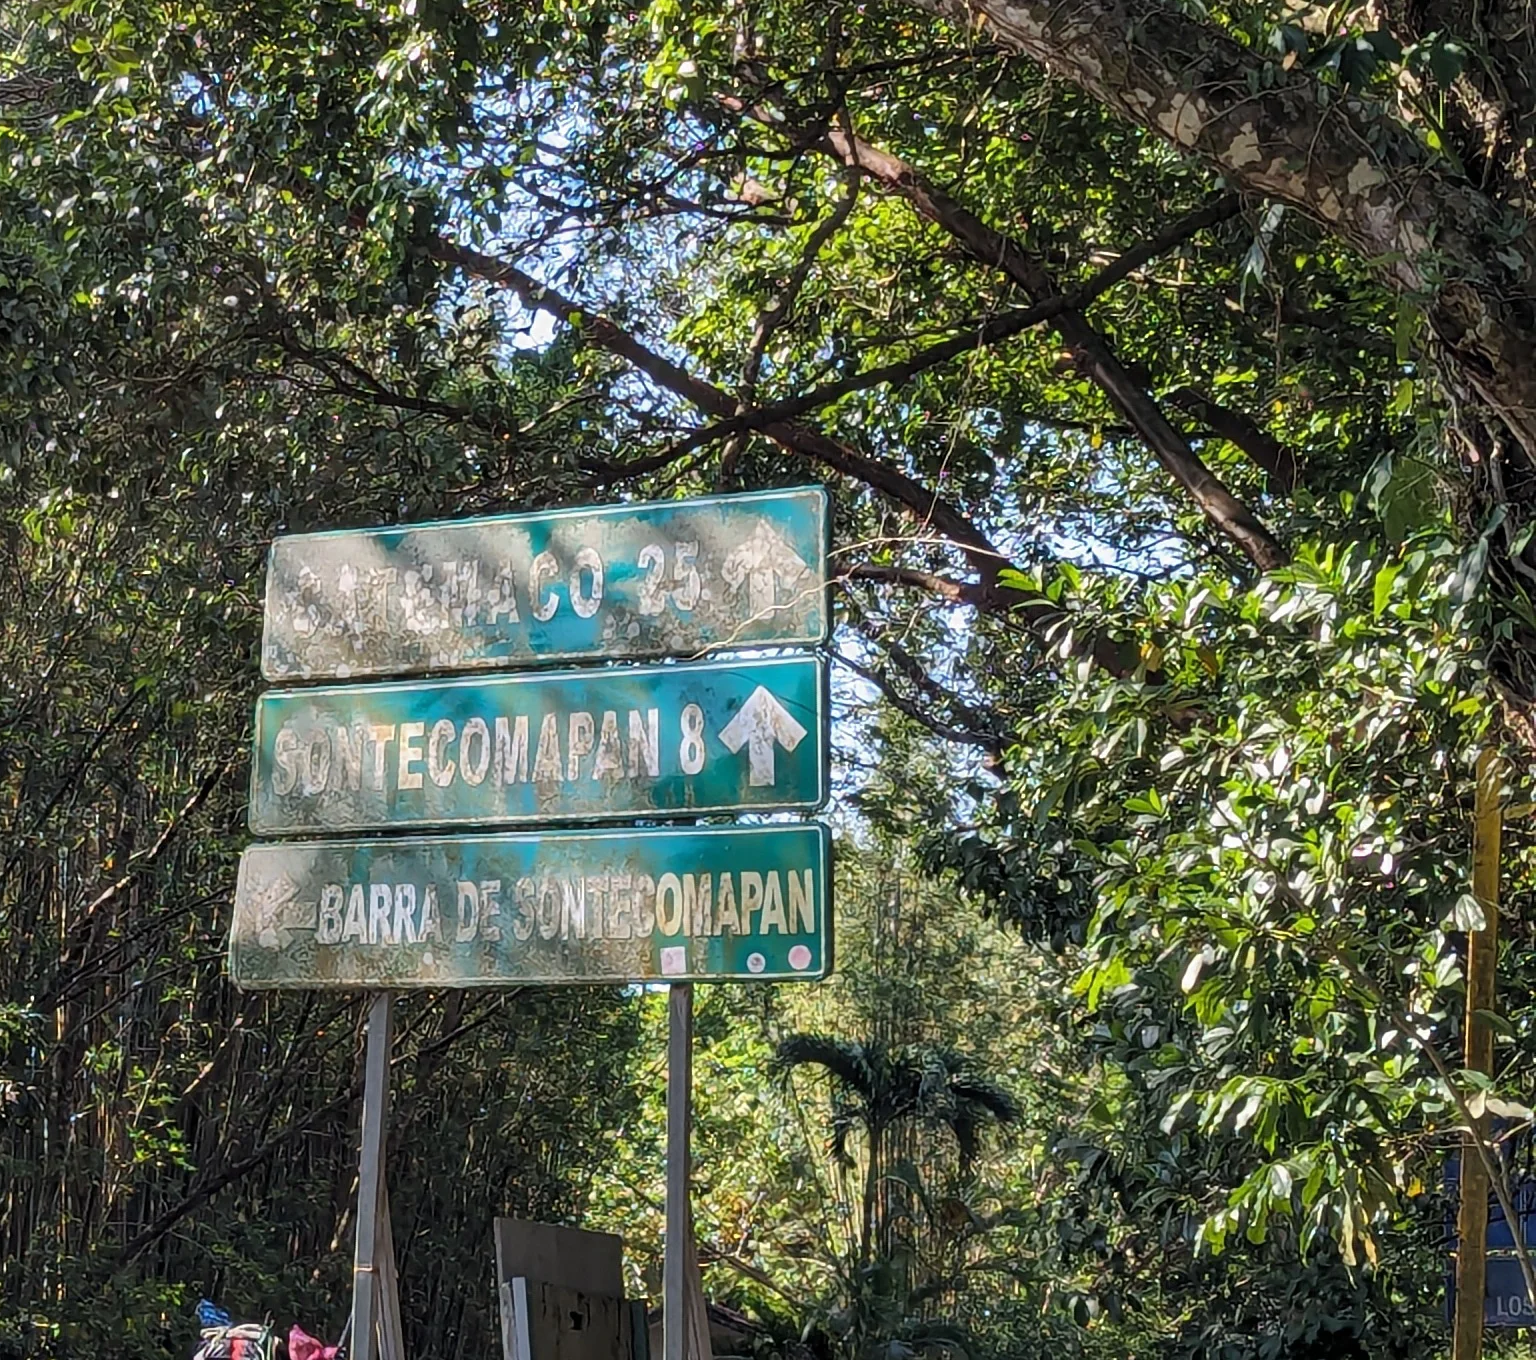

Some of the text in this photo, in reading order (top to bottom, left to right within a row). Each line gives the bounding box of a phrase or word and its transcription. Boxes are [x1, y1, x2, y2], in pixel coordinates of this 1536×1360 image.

[637, 540, 702, 617] 25
[272, 703, 706, 796] SONTECOMAPAN 8
[317, 867, 815, 945] BARRA DE SONTECOMAPAN
